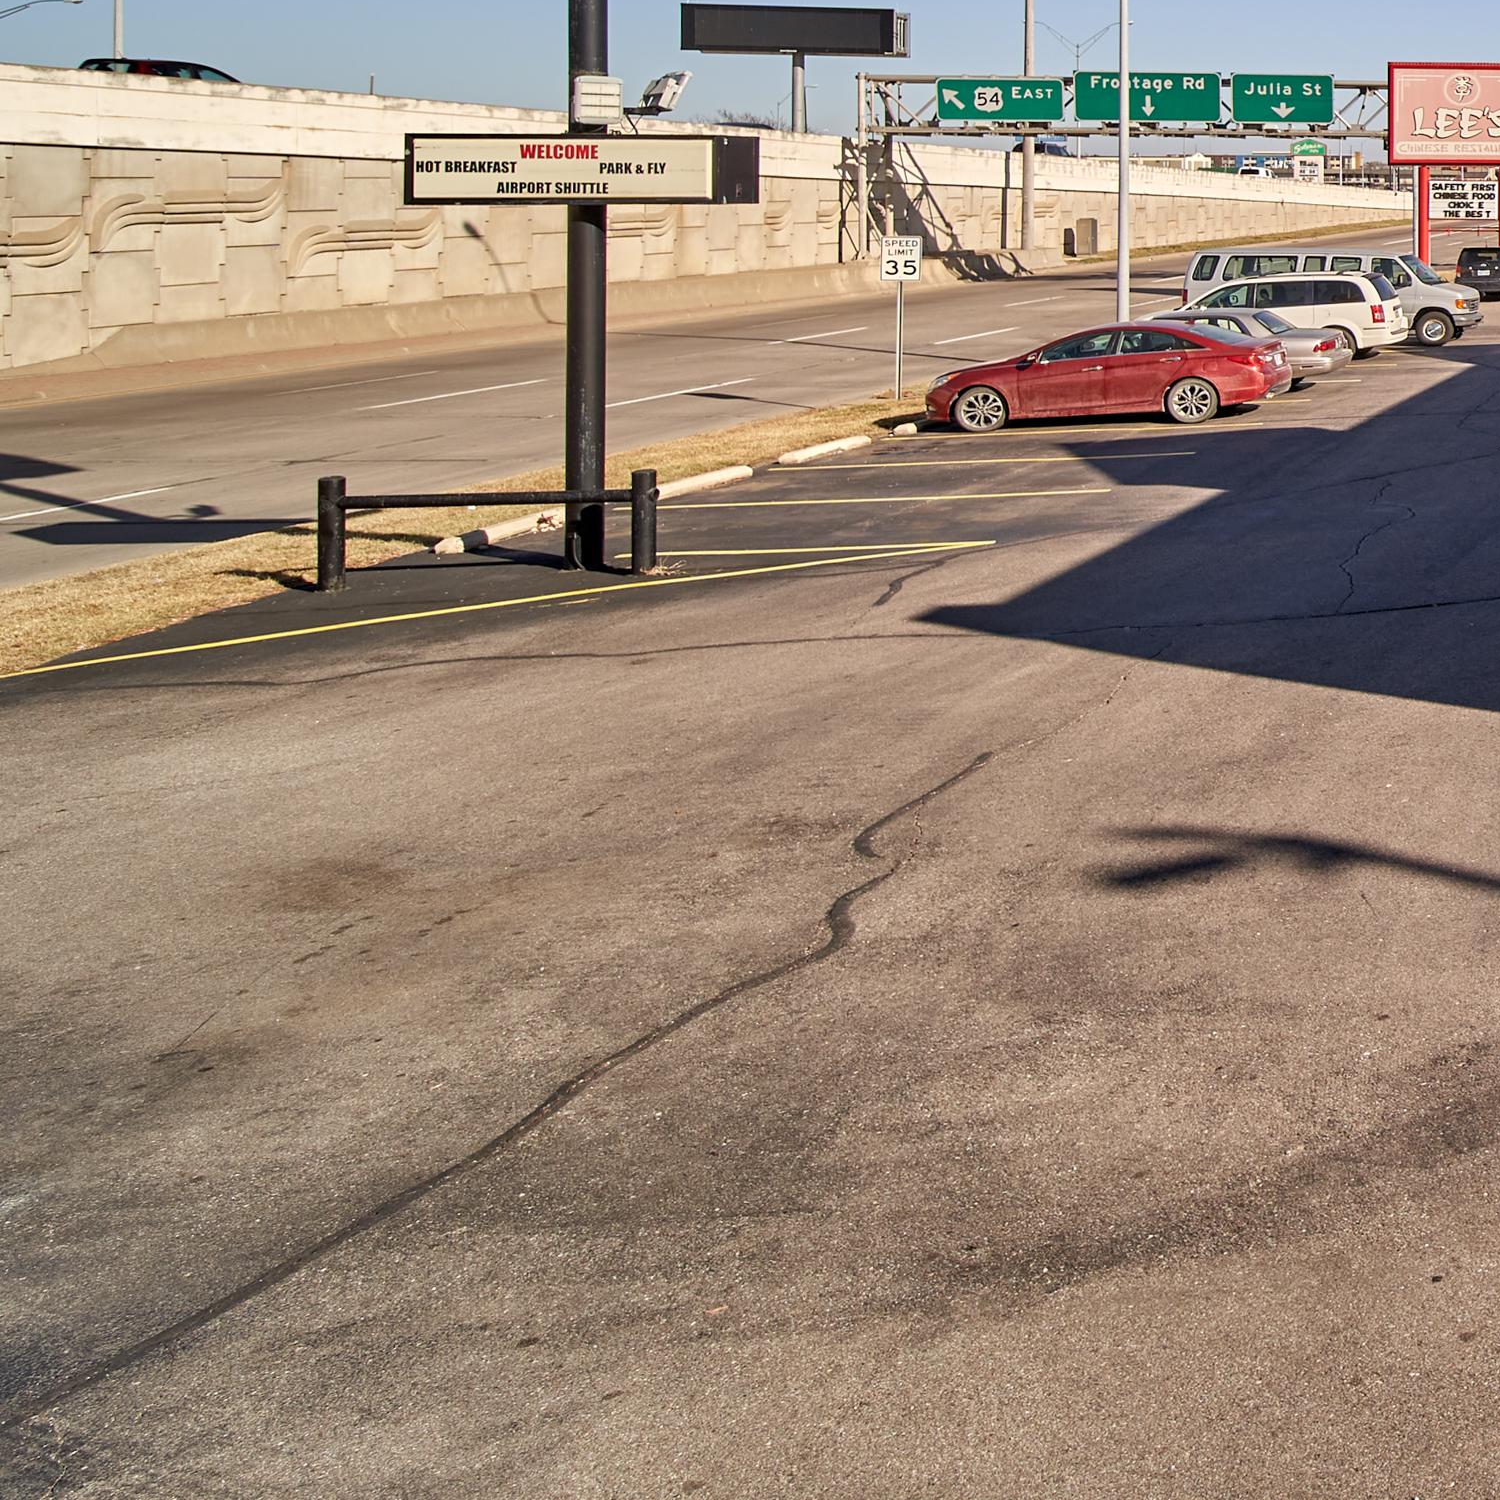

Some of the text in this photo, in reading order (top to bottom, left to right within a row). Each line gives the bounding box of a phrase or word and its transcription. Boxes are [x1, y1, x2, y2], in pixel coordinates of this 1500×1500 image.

[1090, 75, 1205, 92] Frotage Rd
[1244, 82, 1322, 96] Julia St
[977, 86, 1053, 106] 54 EAST
[520, 144, 599, 159] WELCOME
[1399, 143, 1449, 153] CHINESE
[416, 161, 517, 173] HOT BREAKFAST
[600, 162, 666, 174] PARK & FLY
[496, 182, 609, 194] AIRPORT SHUTTLE
[1472, 192, 1495, 200] FOOD
[885, 260, 917, 275] 35
